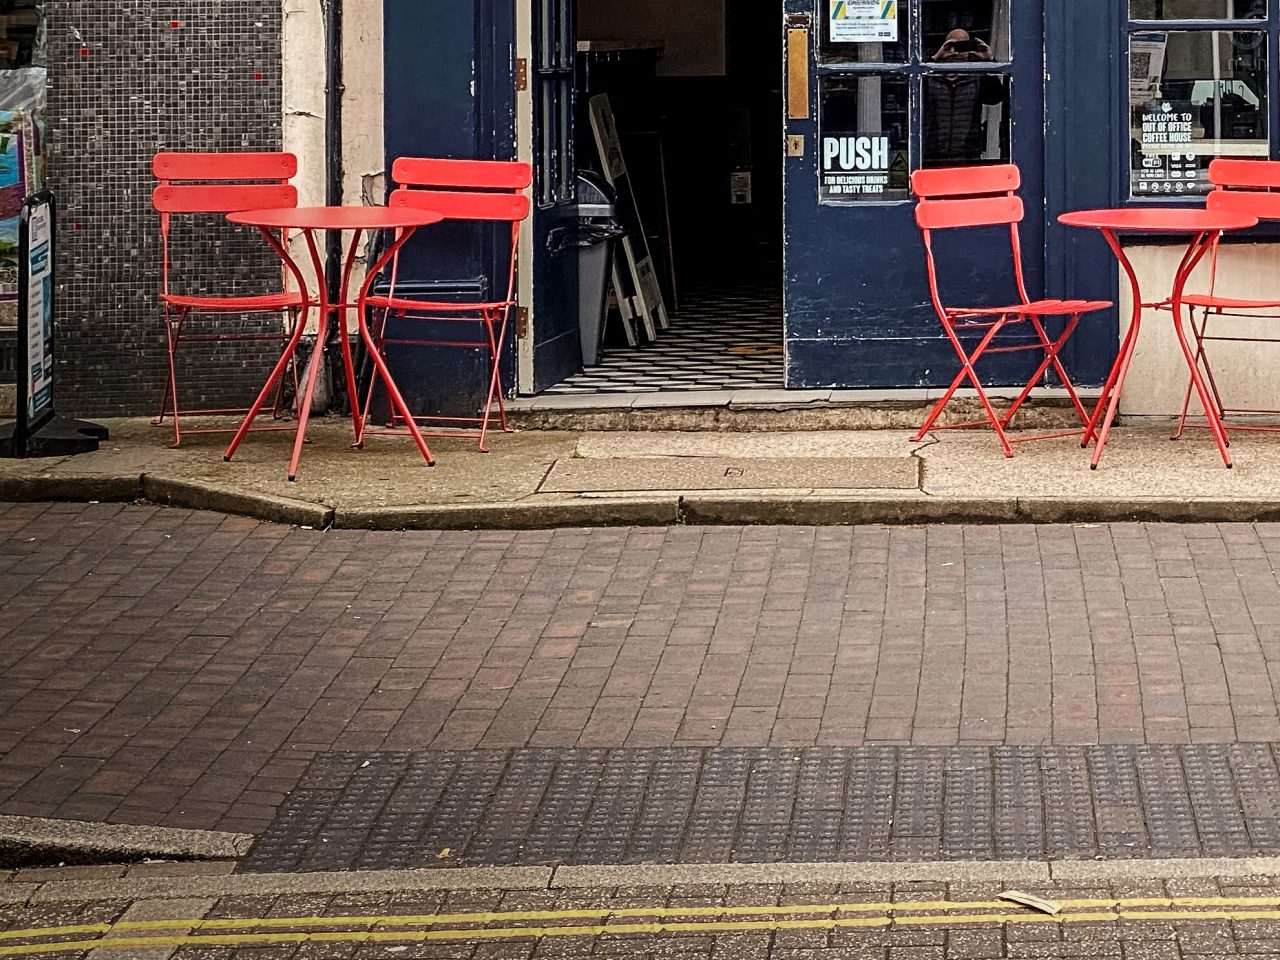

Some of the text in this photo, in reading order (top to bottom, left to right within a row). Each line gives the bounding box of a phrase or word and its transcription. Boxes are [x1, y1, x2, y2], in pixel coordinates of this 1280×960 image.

[1142, 113, 1192, 122] WELCOME TO
[1142, 122, 1192, 132] OUT OF OFFICE
[1142, 132, 1192, 143] COFFEE HOUSE
[823, 136, 889, 170] PUSH
[824, 175, 888, 185] FOR DELICIOUS DRINKS
[828, 185, 884, 194] AND TASTY TREATS
